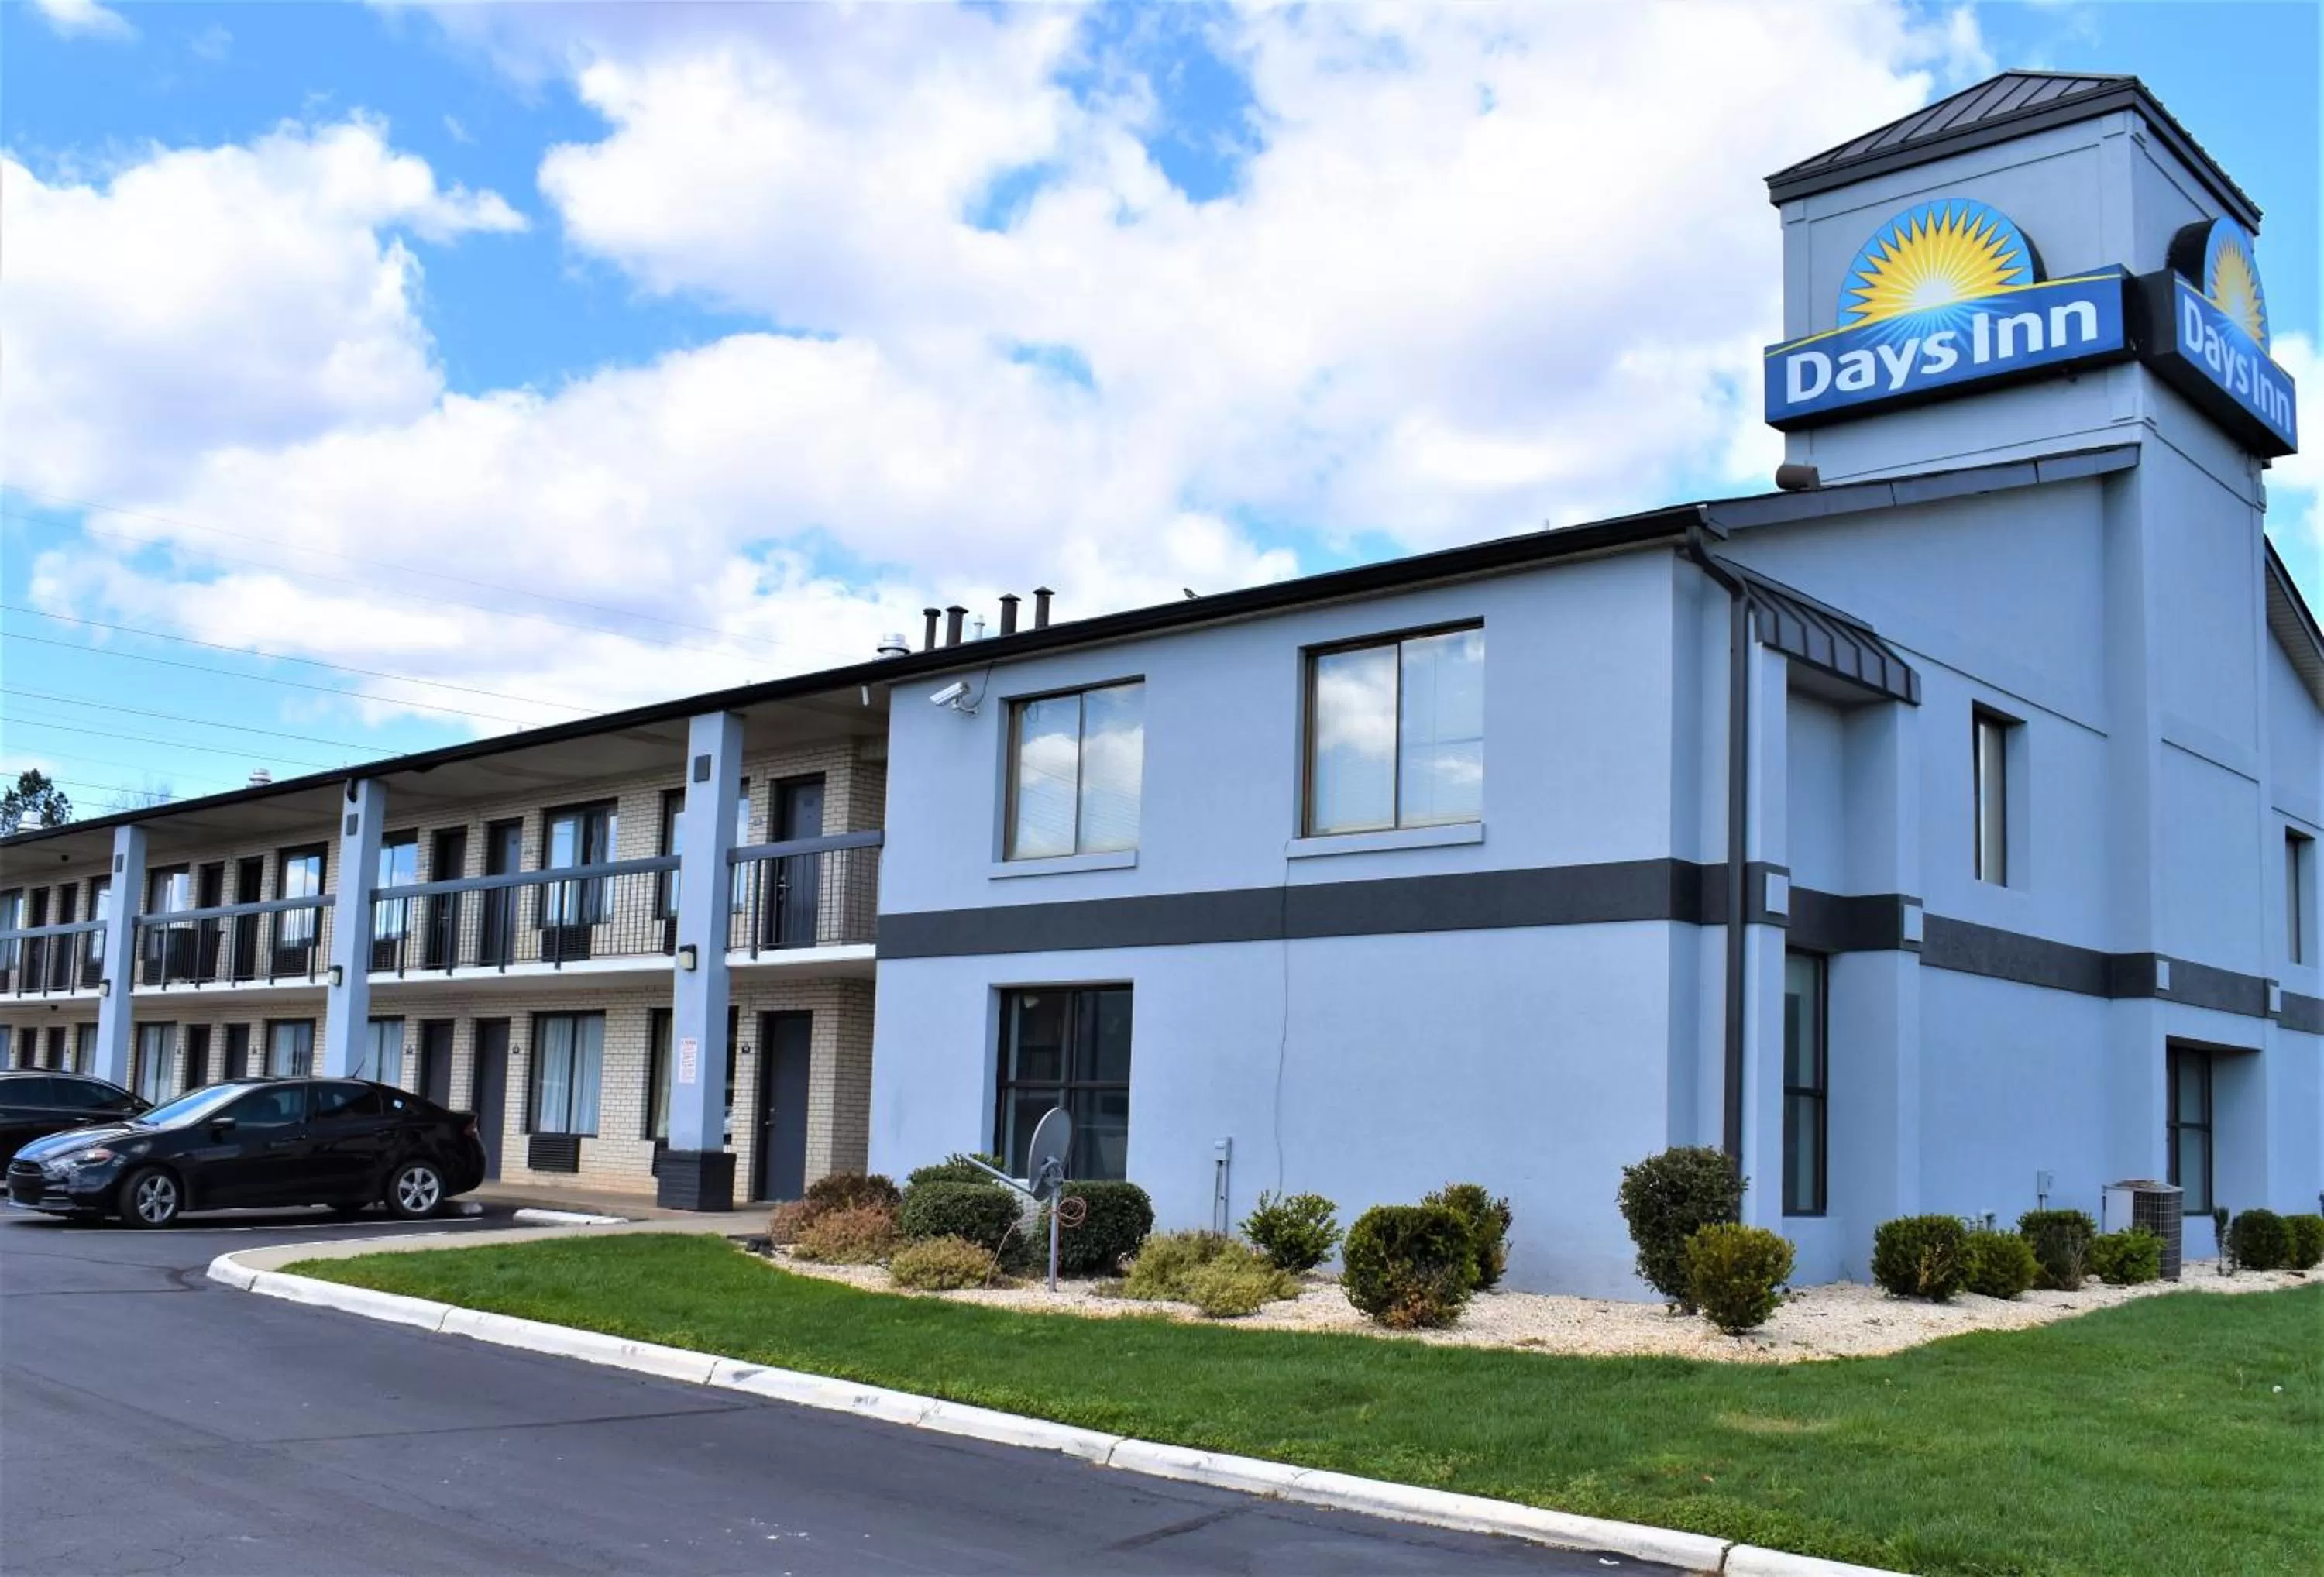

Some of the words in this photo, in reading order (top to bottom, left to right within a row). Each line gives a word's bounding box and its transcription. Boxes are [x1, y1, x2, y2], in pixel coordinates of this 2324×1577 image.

[1786, 330, 1956, 404] Days
[1974, 300, 2098, 364] Inn
[2183, 294, 2248, 394] Days
[2251, 356, 2291, 433] Inn
